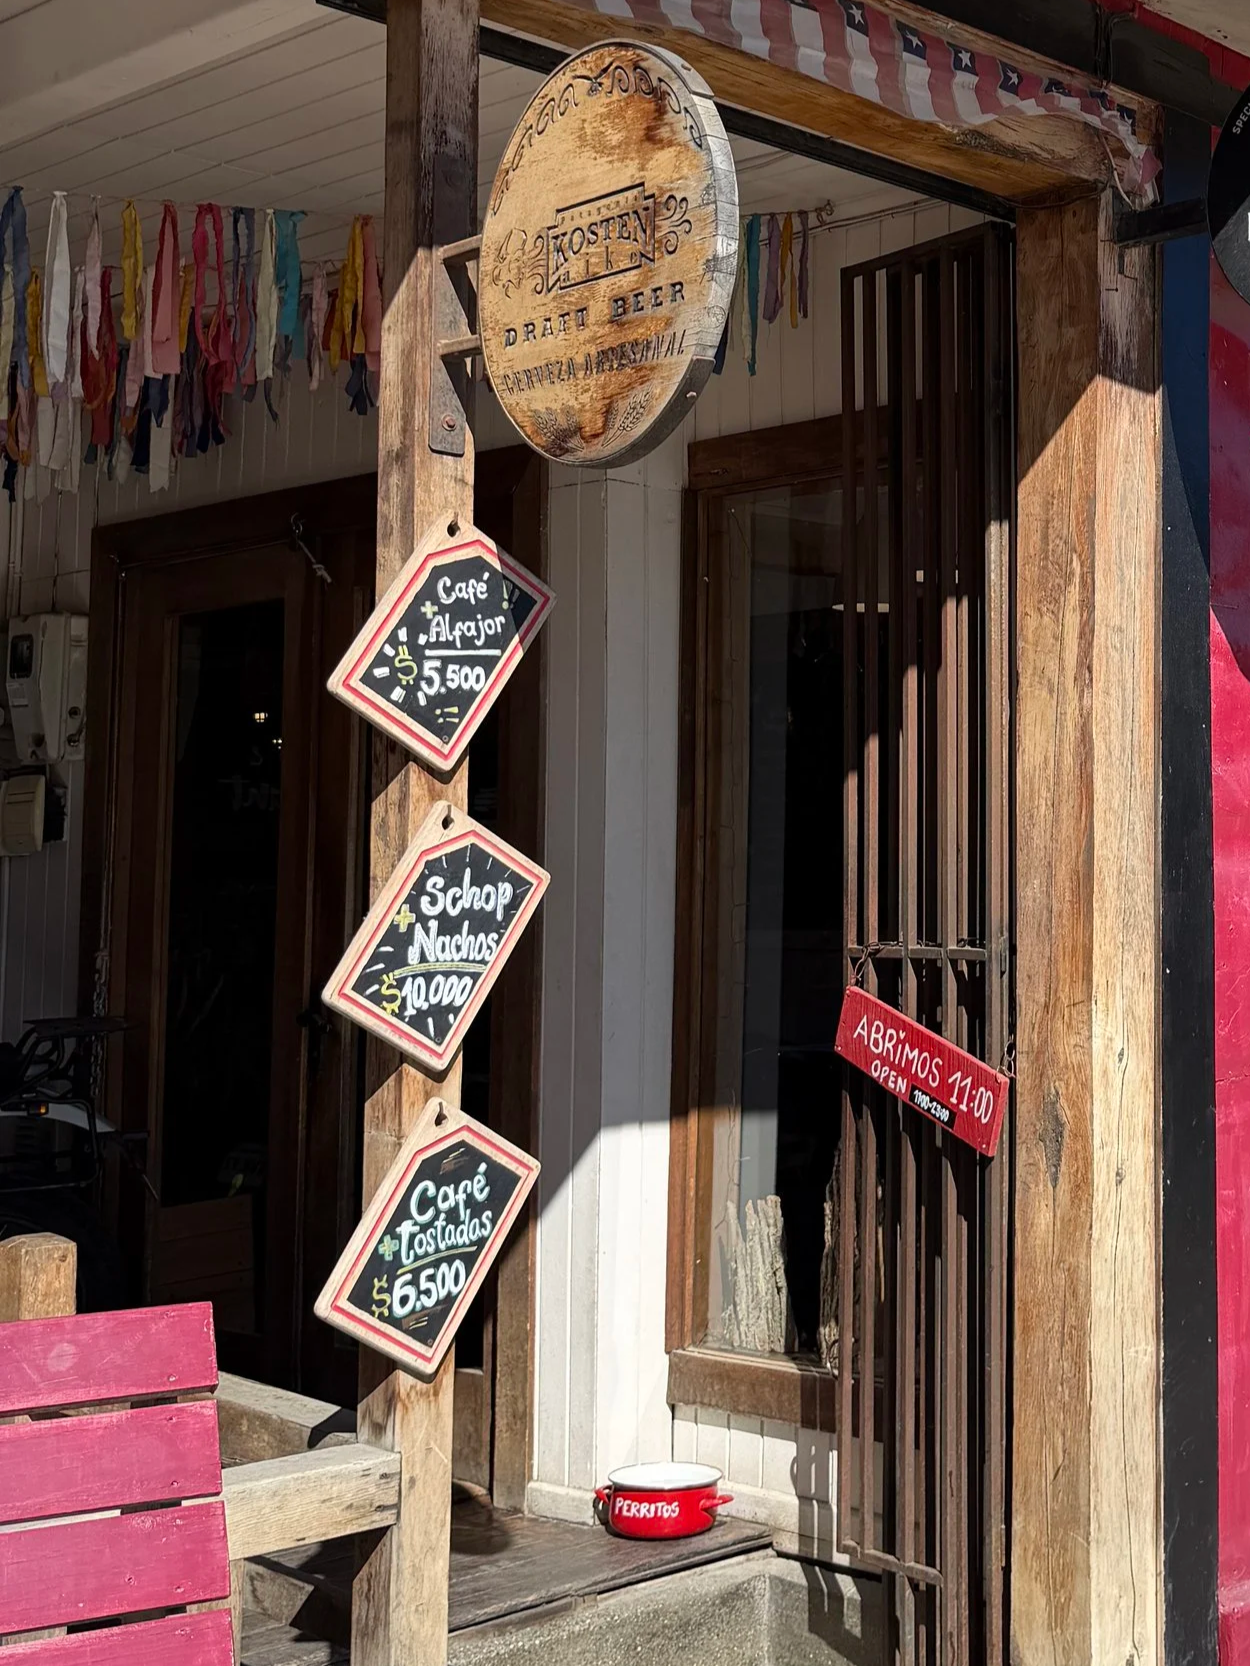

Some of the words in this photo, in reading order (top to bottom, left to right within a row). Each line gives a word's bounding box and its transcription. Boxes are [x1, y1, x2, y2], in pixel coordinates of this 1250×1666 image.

[551, 206, 651, 275] KOSTEN
[503, 307, 588, 350] DRAFT
[611, 281, 686, 323] BEER
[503, 357, 577, 396] CERVEZA
[583, 329, 687, 378] ARTESANAL
[436, 571, 490, 605] Café
[428, 613, 506, 649] Alfajor
[420, 867, 514, 922] Schop
[407, 918, 499, 966] Nachos
[871, 1060, 908, 1094] OPEN
[948, 1071, 994, 1125] 11:00
[409, 1161, 491, 1224] Café
[614, 1496, 680, 1519] PERRITOS
